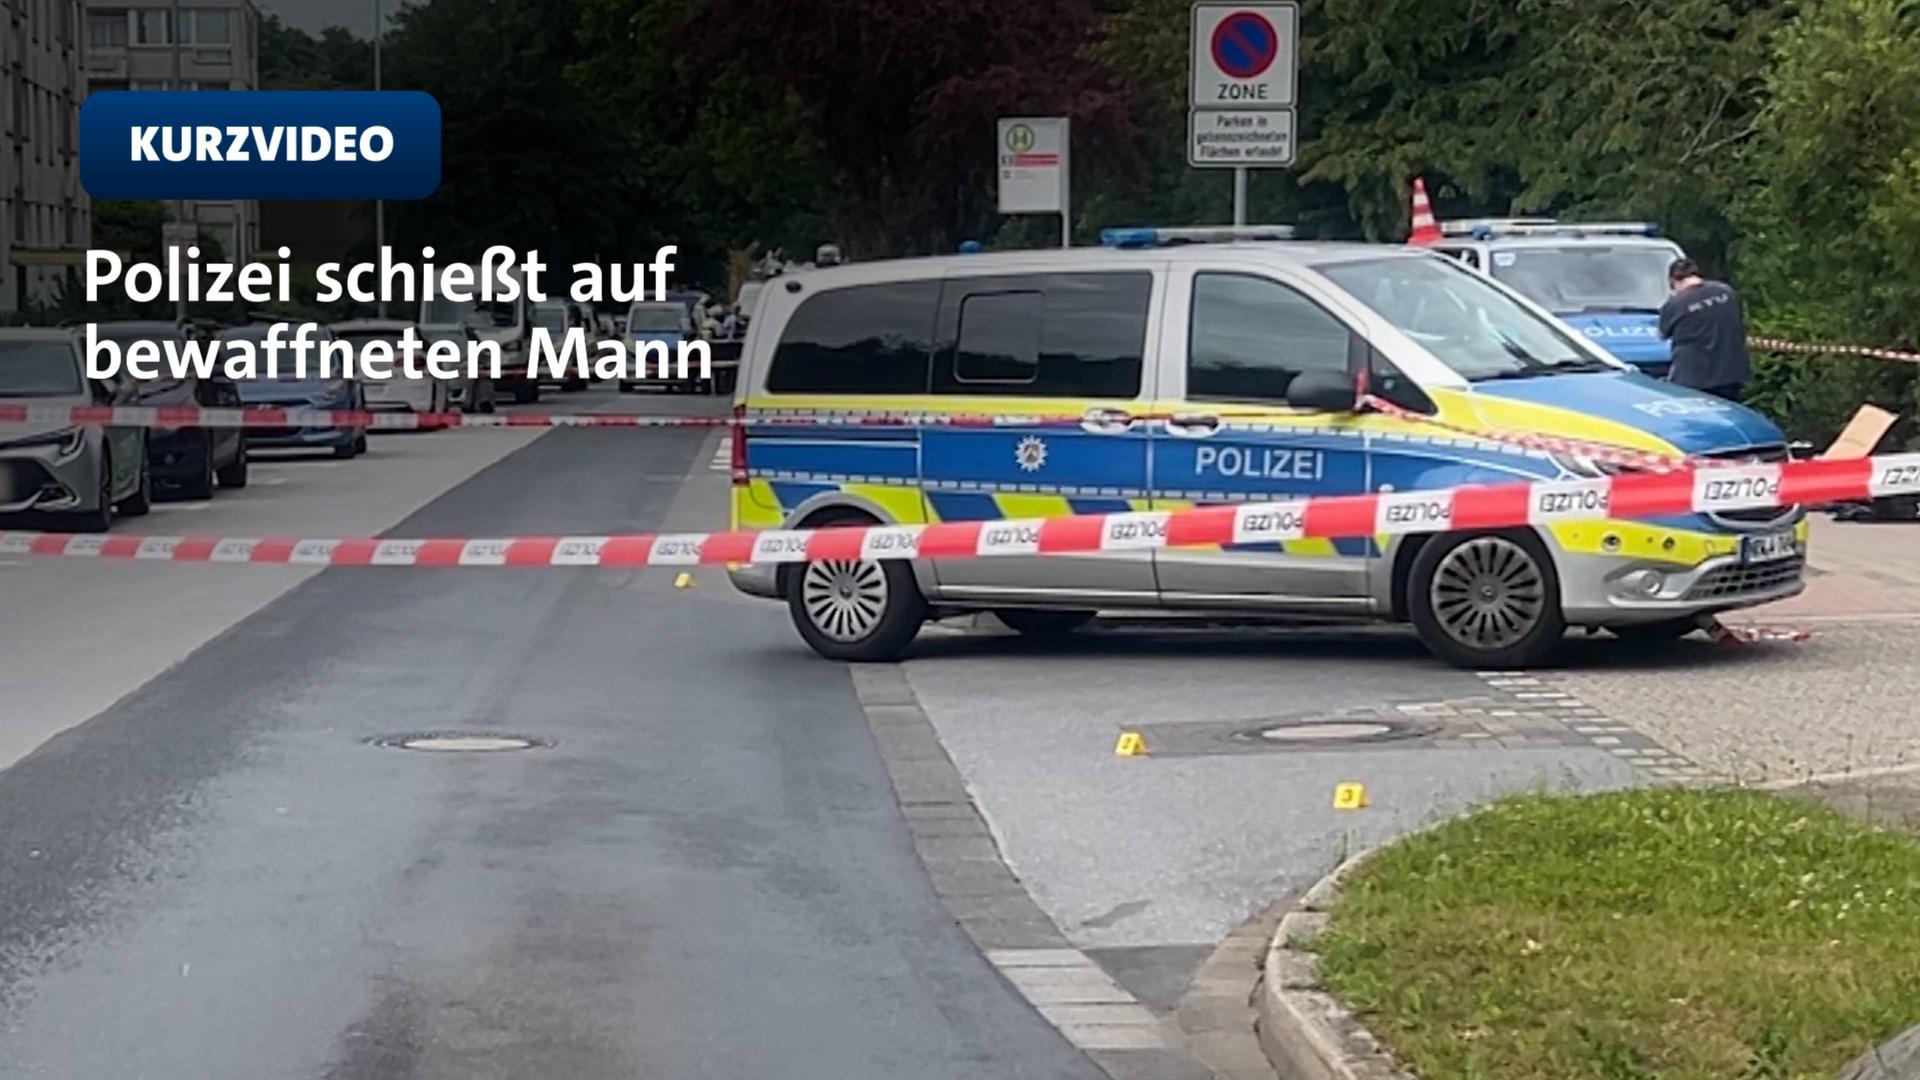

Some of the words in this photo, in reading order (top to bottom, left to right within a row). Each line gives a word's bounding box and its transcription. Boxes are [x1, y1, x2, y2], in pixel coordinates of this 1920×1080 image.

[1217, 83, 1268, 99] ZONE
[1216, 114, 1253, 127] Parken
[1195, 446, 1324, 480] POLIZEI
[1704, 478, 1779, 501] POLIZEI
[1539, 490, 1609, 512] POLIZEI
[1243, 511, 1304, 531] POLIZEI
[1386, 502, 1452, 522] POLIZEI
[986, 528, 1038, 546] POLIZEI
[1110, 521, 1166, 540] POLIZEI
